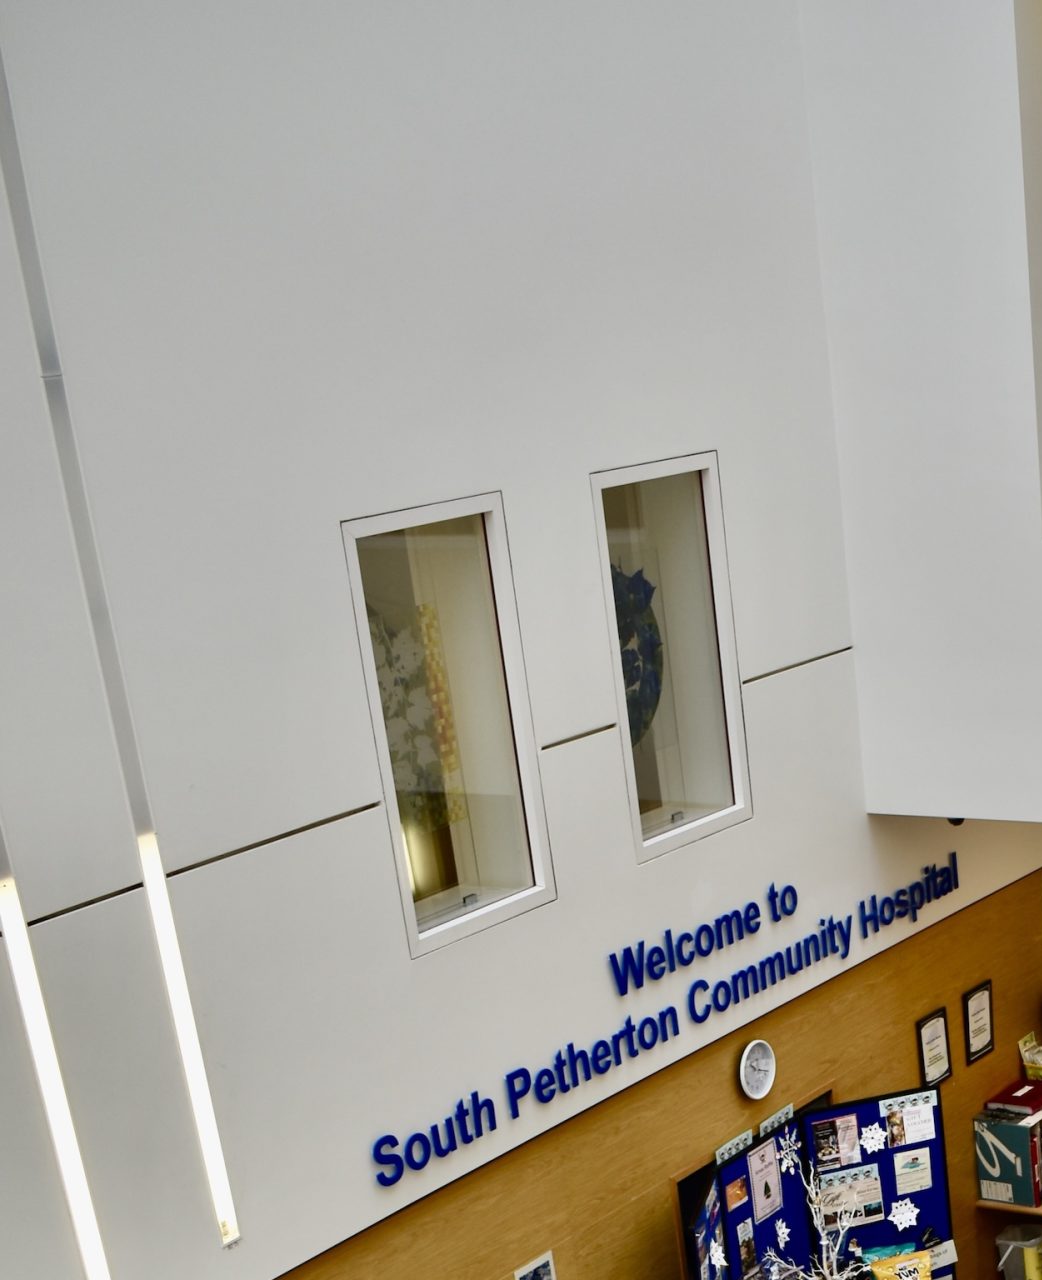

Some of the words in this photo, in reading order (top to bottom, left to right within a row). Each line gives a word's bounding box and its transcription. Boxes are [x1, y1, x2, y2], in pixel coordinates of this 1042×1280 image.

[608, 900, 761, 997] Welcome
[766, 882, 798, 923] to
[372, 1090, 497, 1187] South
[504, 1006, 680, 1119] Petherton
[688, 914, 853, 1024] Community
[858, 851, 960, 939] Hospital
[894, 1267, 920, 1280] YUM
